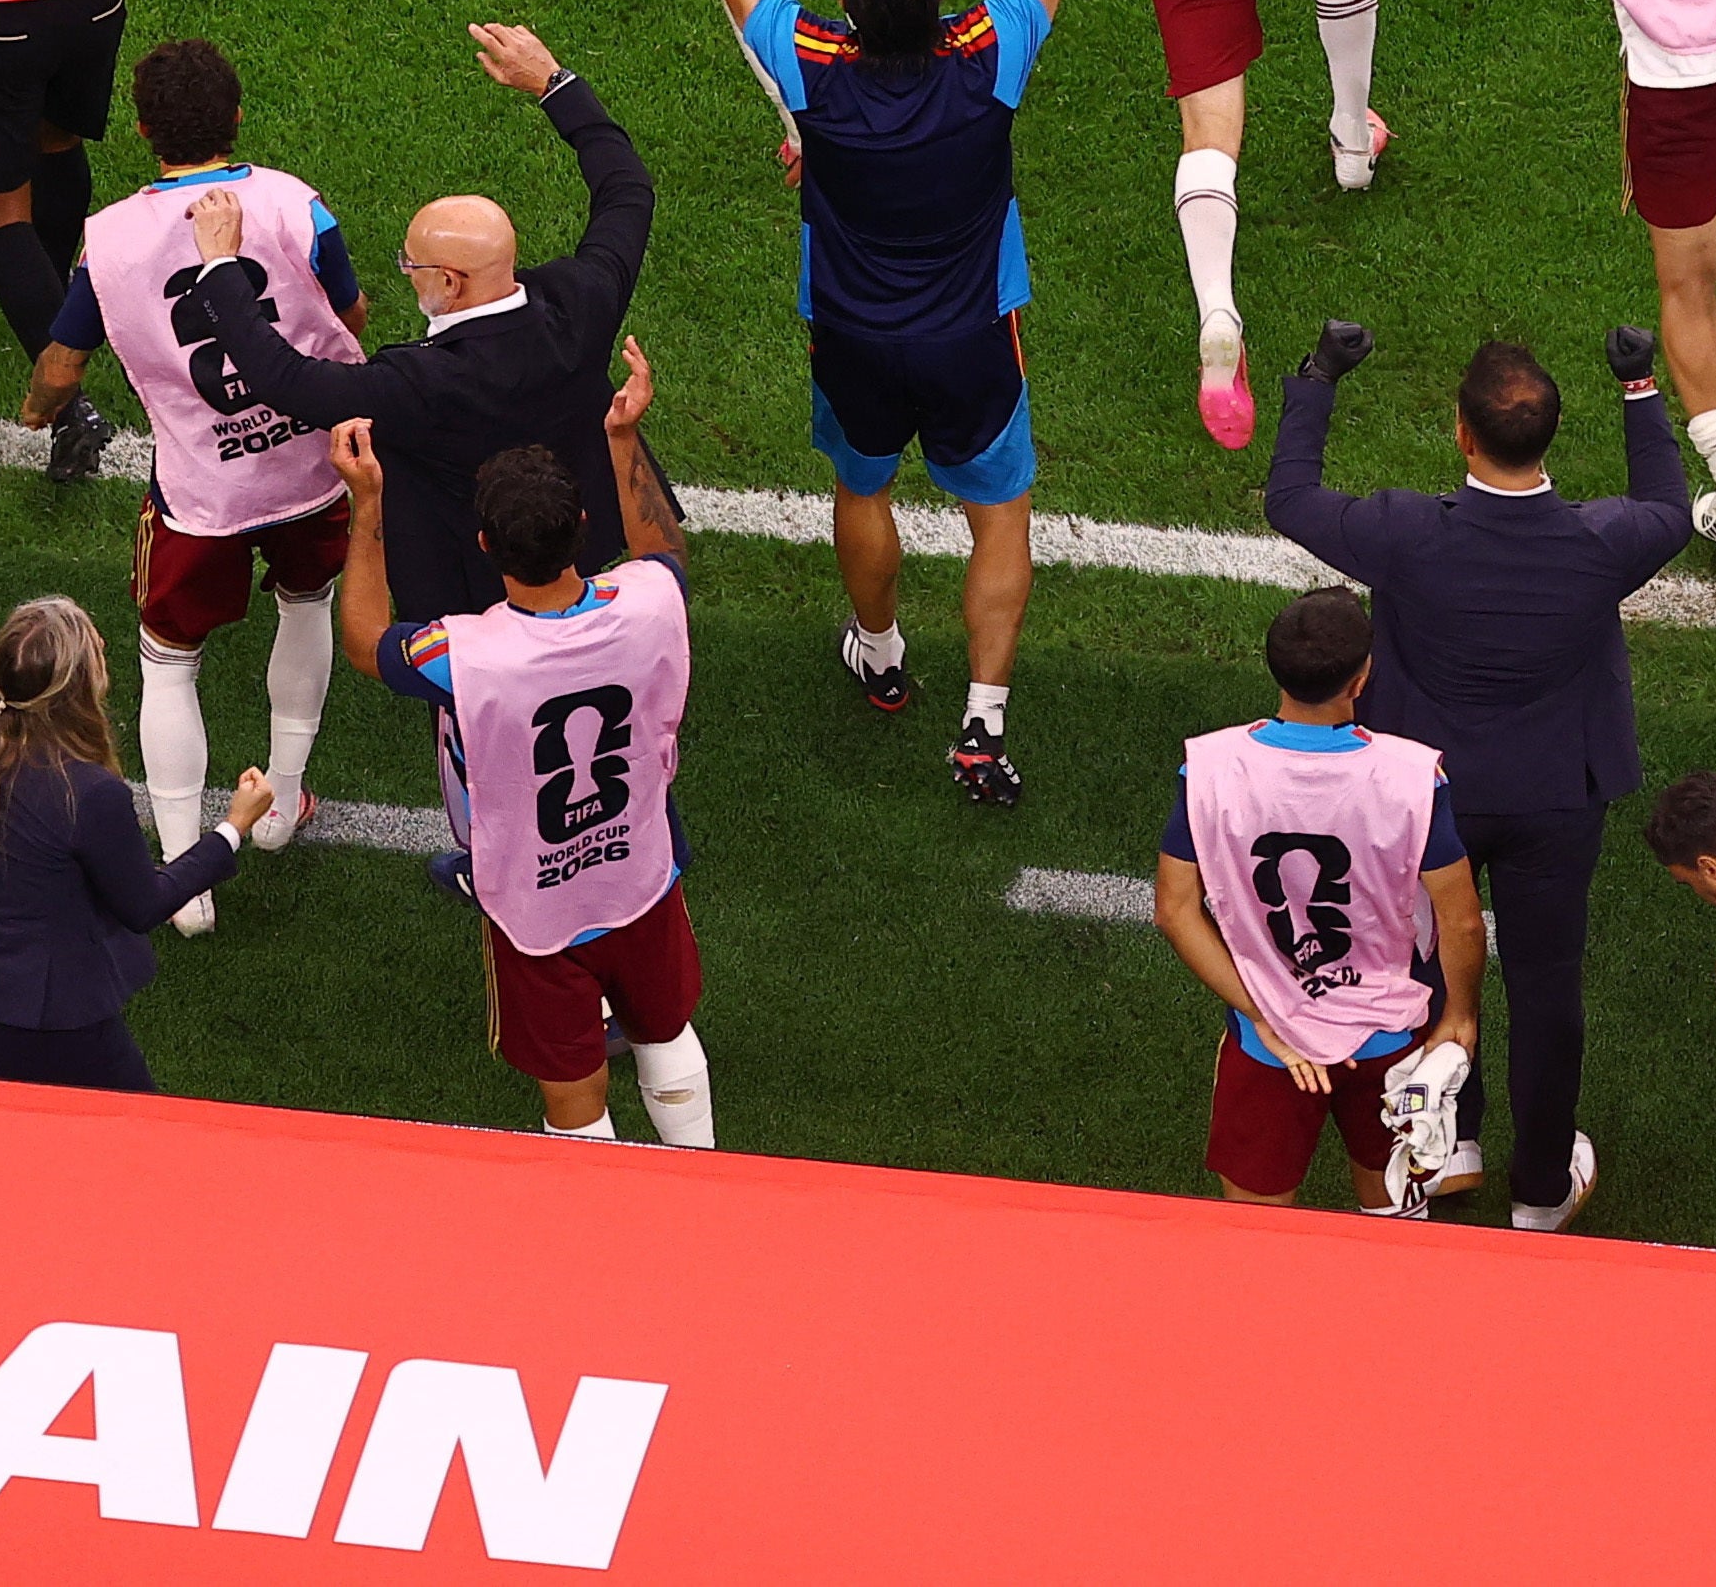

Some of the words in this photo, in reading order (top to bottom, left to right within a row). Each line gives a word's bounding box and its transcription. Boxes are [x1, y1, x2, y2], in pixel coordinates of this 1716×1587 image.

[211, 409, 273, 438] WORLD
[564, 798, 603, 828] FIFA
[537, 835, 593, 867] WORLD
[594, 825, 631, 843] CUP
[536, 840, 630, 890] 2026
